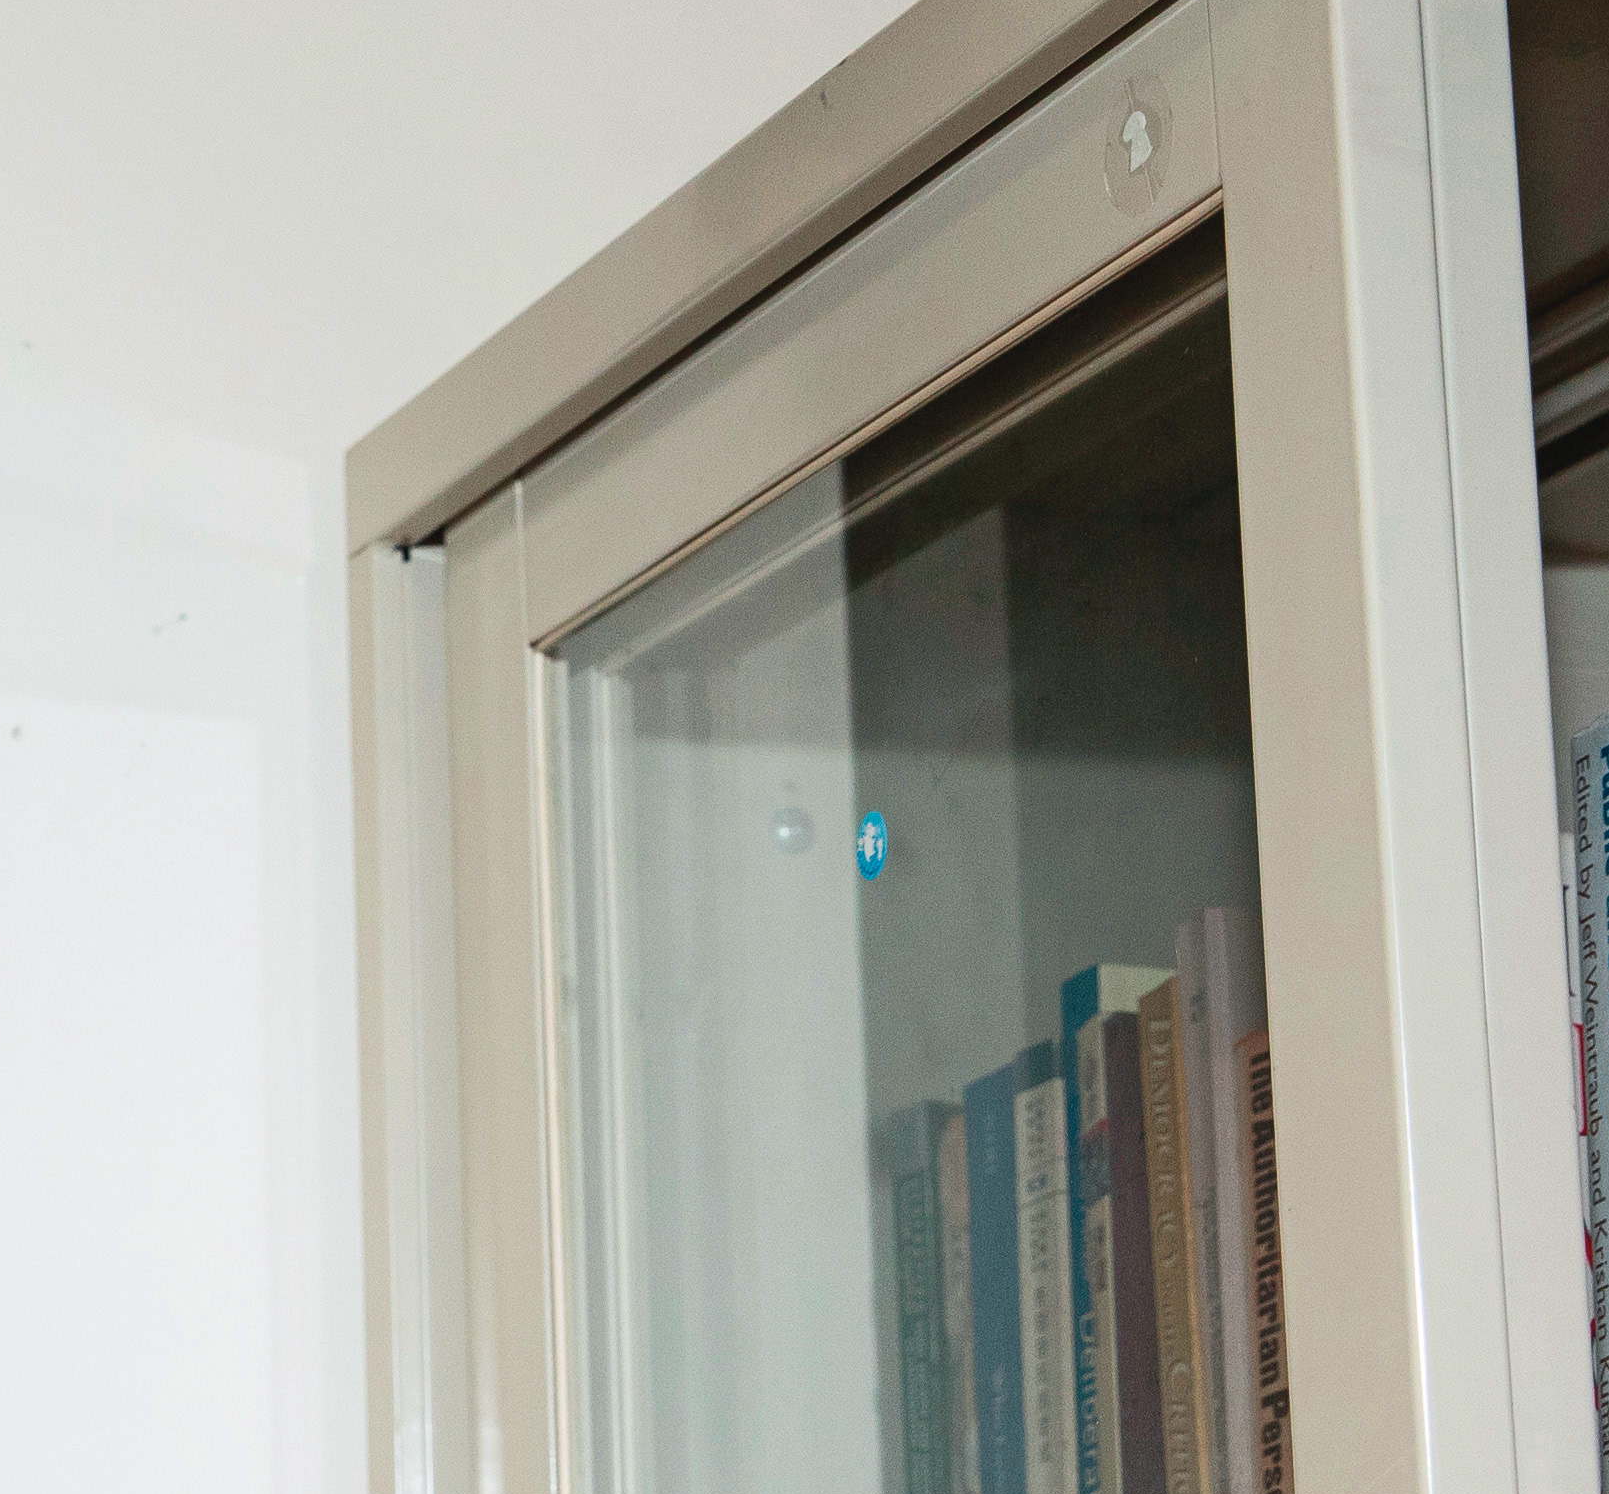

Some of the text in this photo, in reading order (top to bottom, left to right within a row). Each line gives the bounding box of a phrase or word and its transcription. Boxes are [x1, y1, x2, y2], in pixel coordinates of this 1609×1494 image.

[1576, 754, 1592, 854] Edited
[1579, 865, 1598, 900] by
[1582, 911, 1598, 960] Jeff
[1583, 964, 1600, 1137] Weintraub
[1590, 1149, 1606, 1206] and
